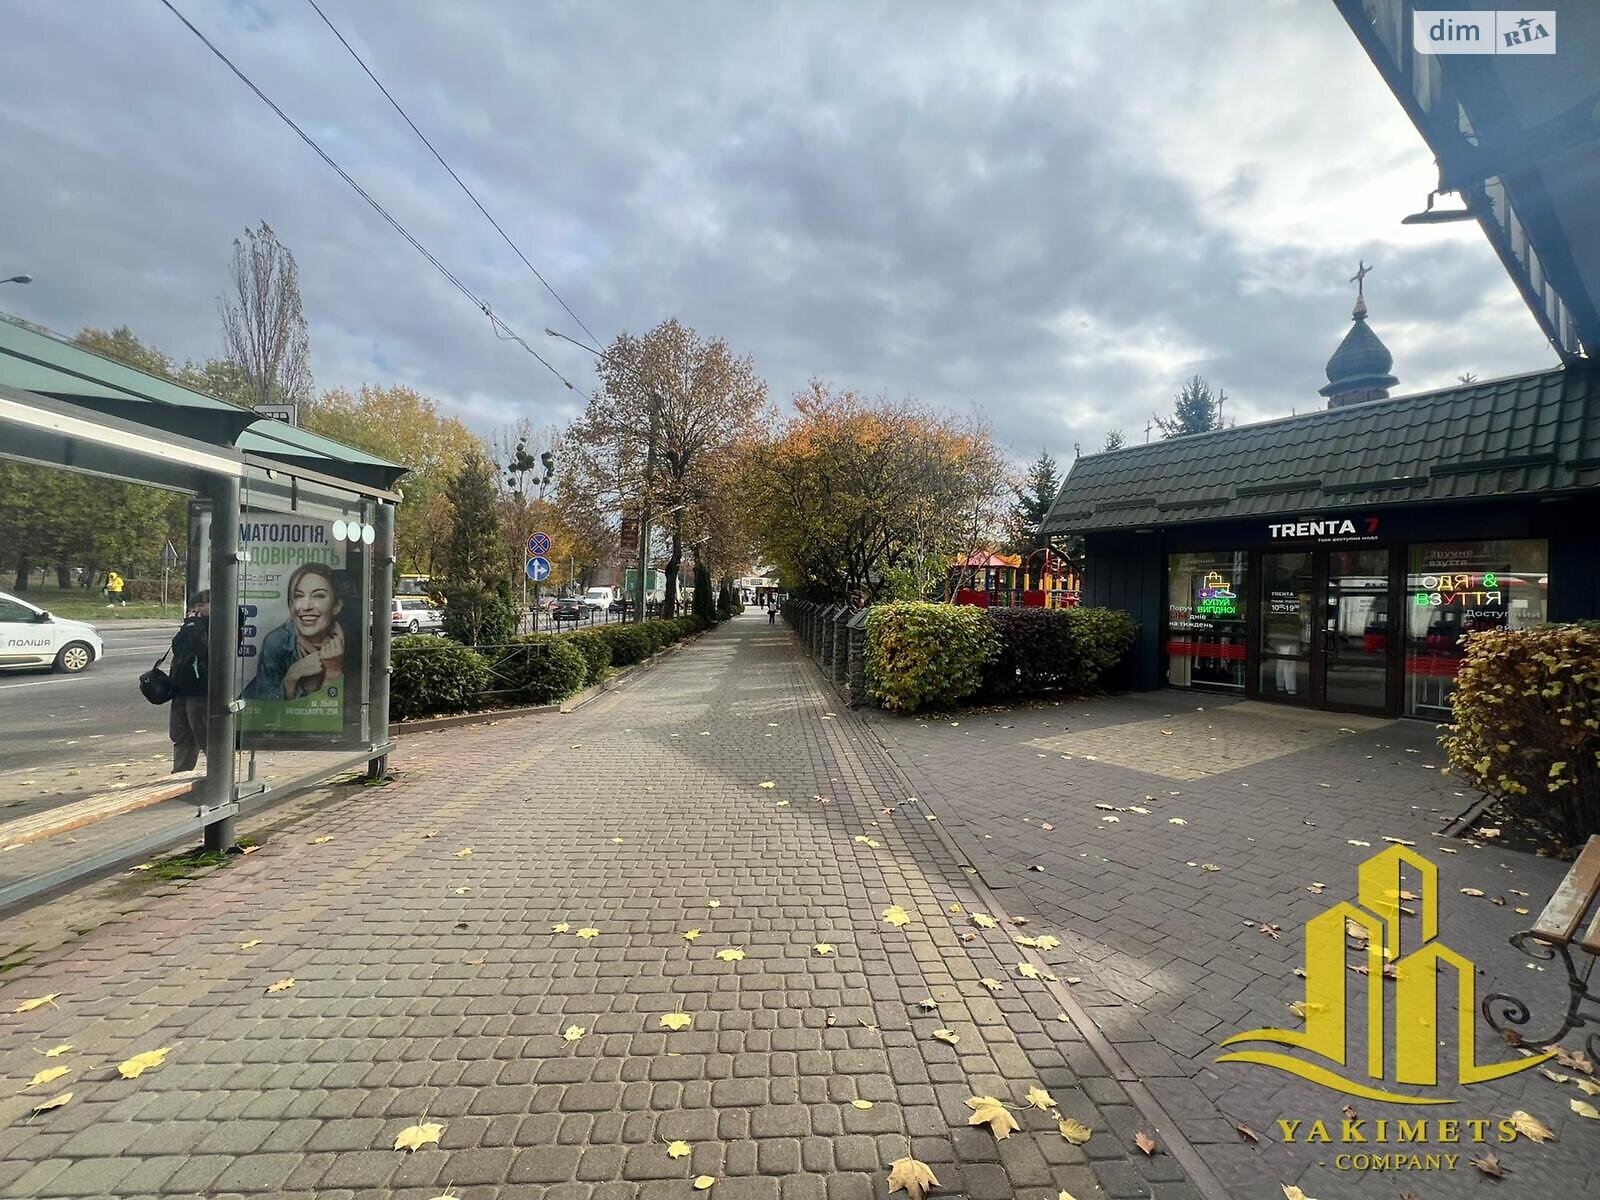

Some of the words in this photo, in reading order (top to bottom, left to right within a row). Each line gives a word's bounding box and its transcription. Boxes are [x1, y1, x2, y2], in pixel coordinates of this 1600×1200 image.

[240, 523, 328, 546] МАТОЛОГІЯ,
[1268, 520, 1356, 538] TRENTA
[249, 546, 340, 567] ДОВІРЯЮТЬ
[1483, 571, 1499, 588] &
[1416, 591, 1501, 608] ВЗУТТЯ
[8, 639, 50, 647] ПОЛІЦІЯ
